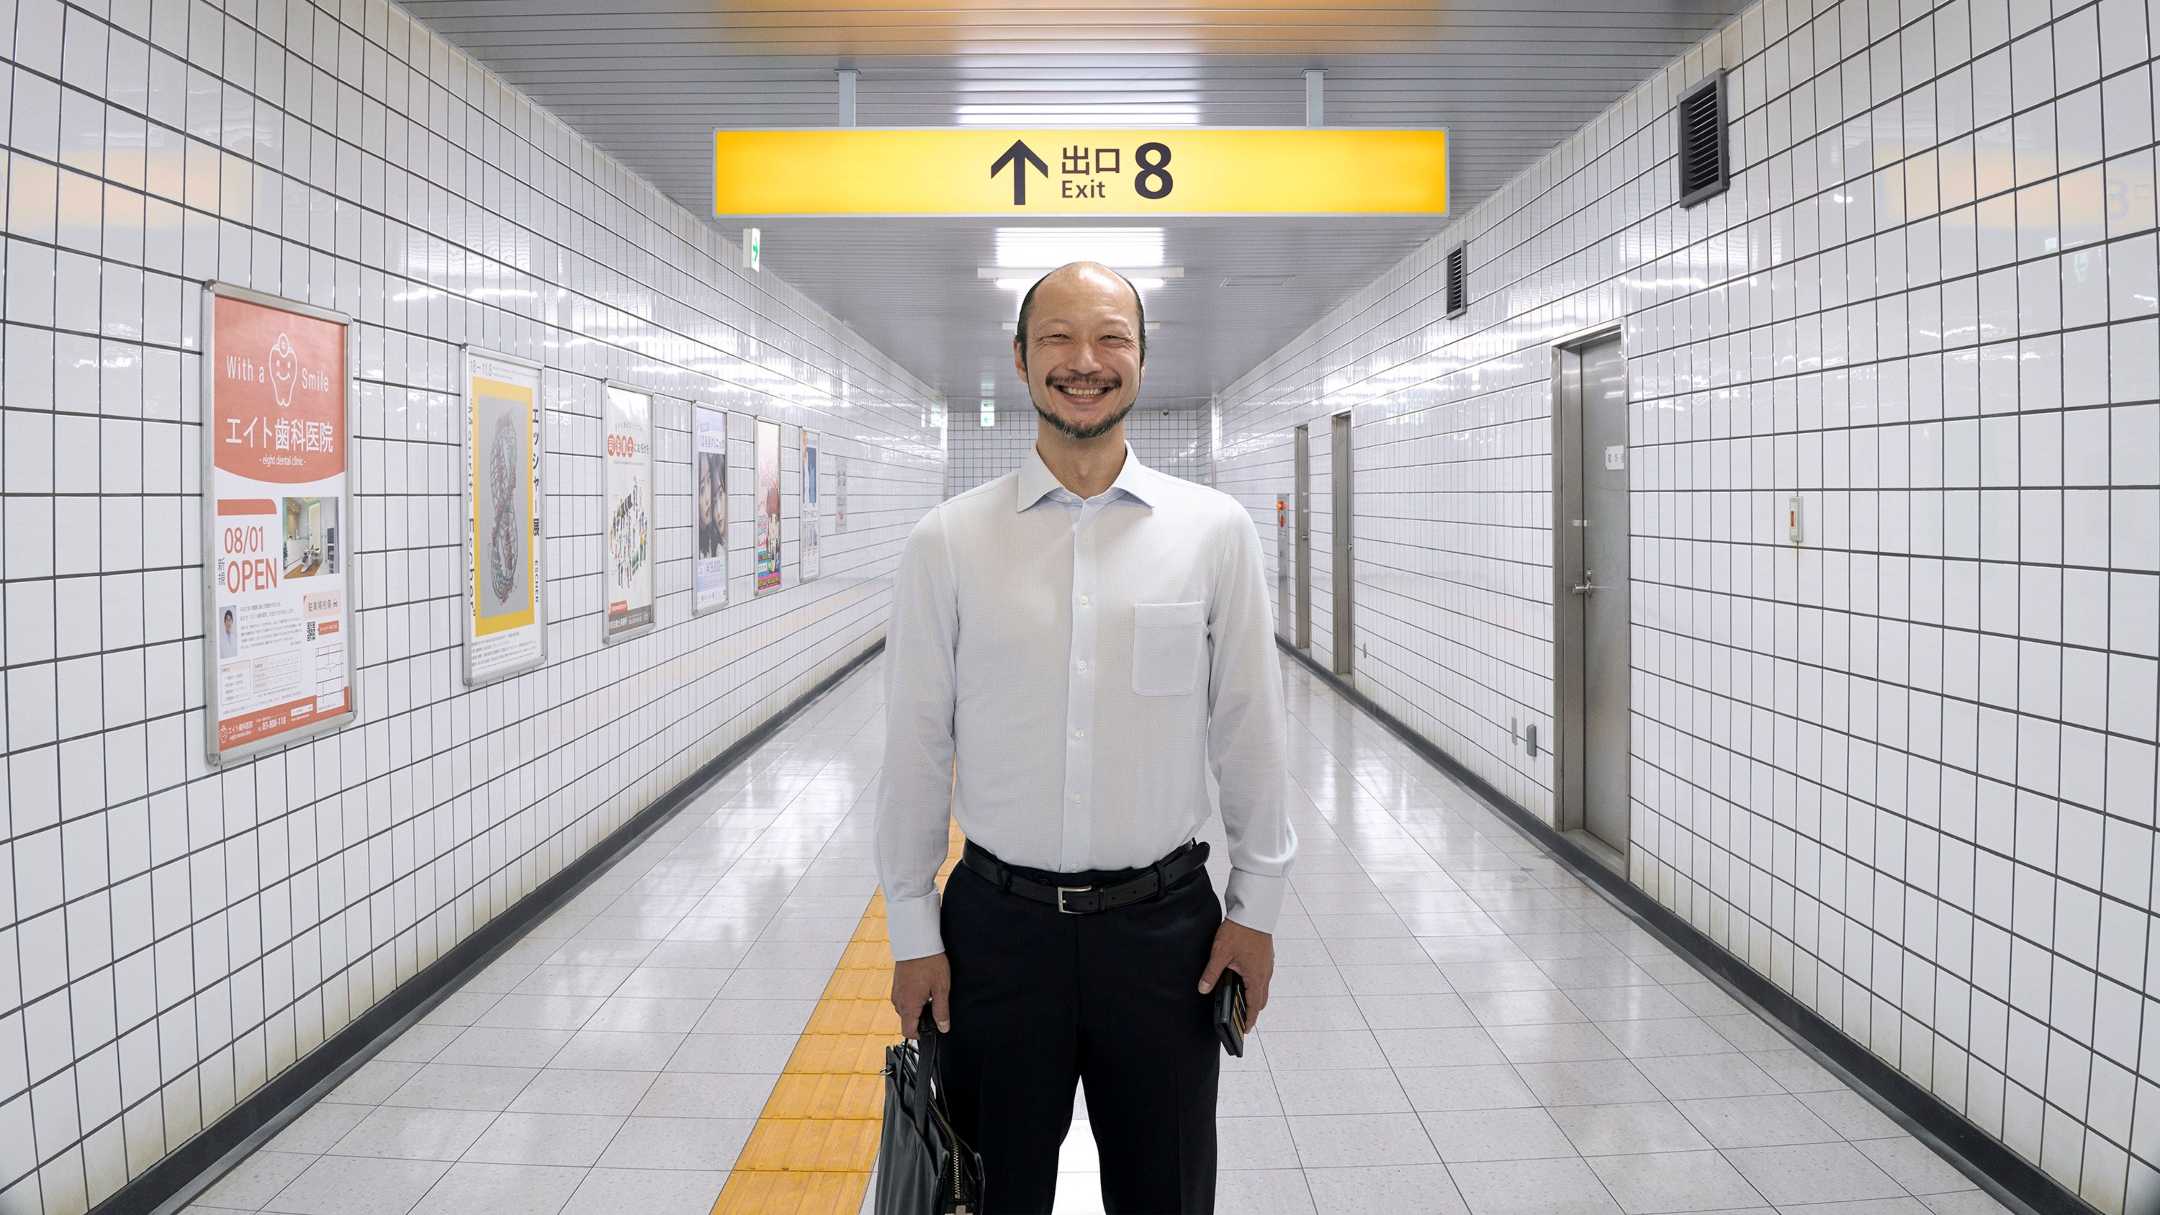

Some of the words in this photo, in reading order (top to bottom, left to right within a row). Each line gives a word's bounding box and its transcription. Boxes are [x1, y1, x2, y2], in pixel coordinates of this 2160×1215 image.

[1062, 145, 1120, 176] 出口
[1134, 142, 1174, 200] 8
[1062, 179, 1106, 198] Exit
[226, 355, 254, 382] With
[259, 366, 265, 384] a
[301, 367, 329, 393] Smile
[225, 416, 334, 453] エイト歯科医院
[224, 525, 264, 554] 08/01
[226, 557, 277, 594] OPEN
